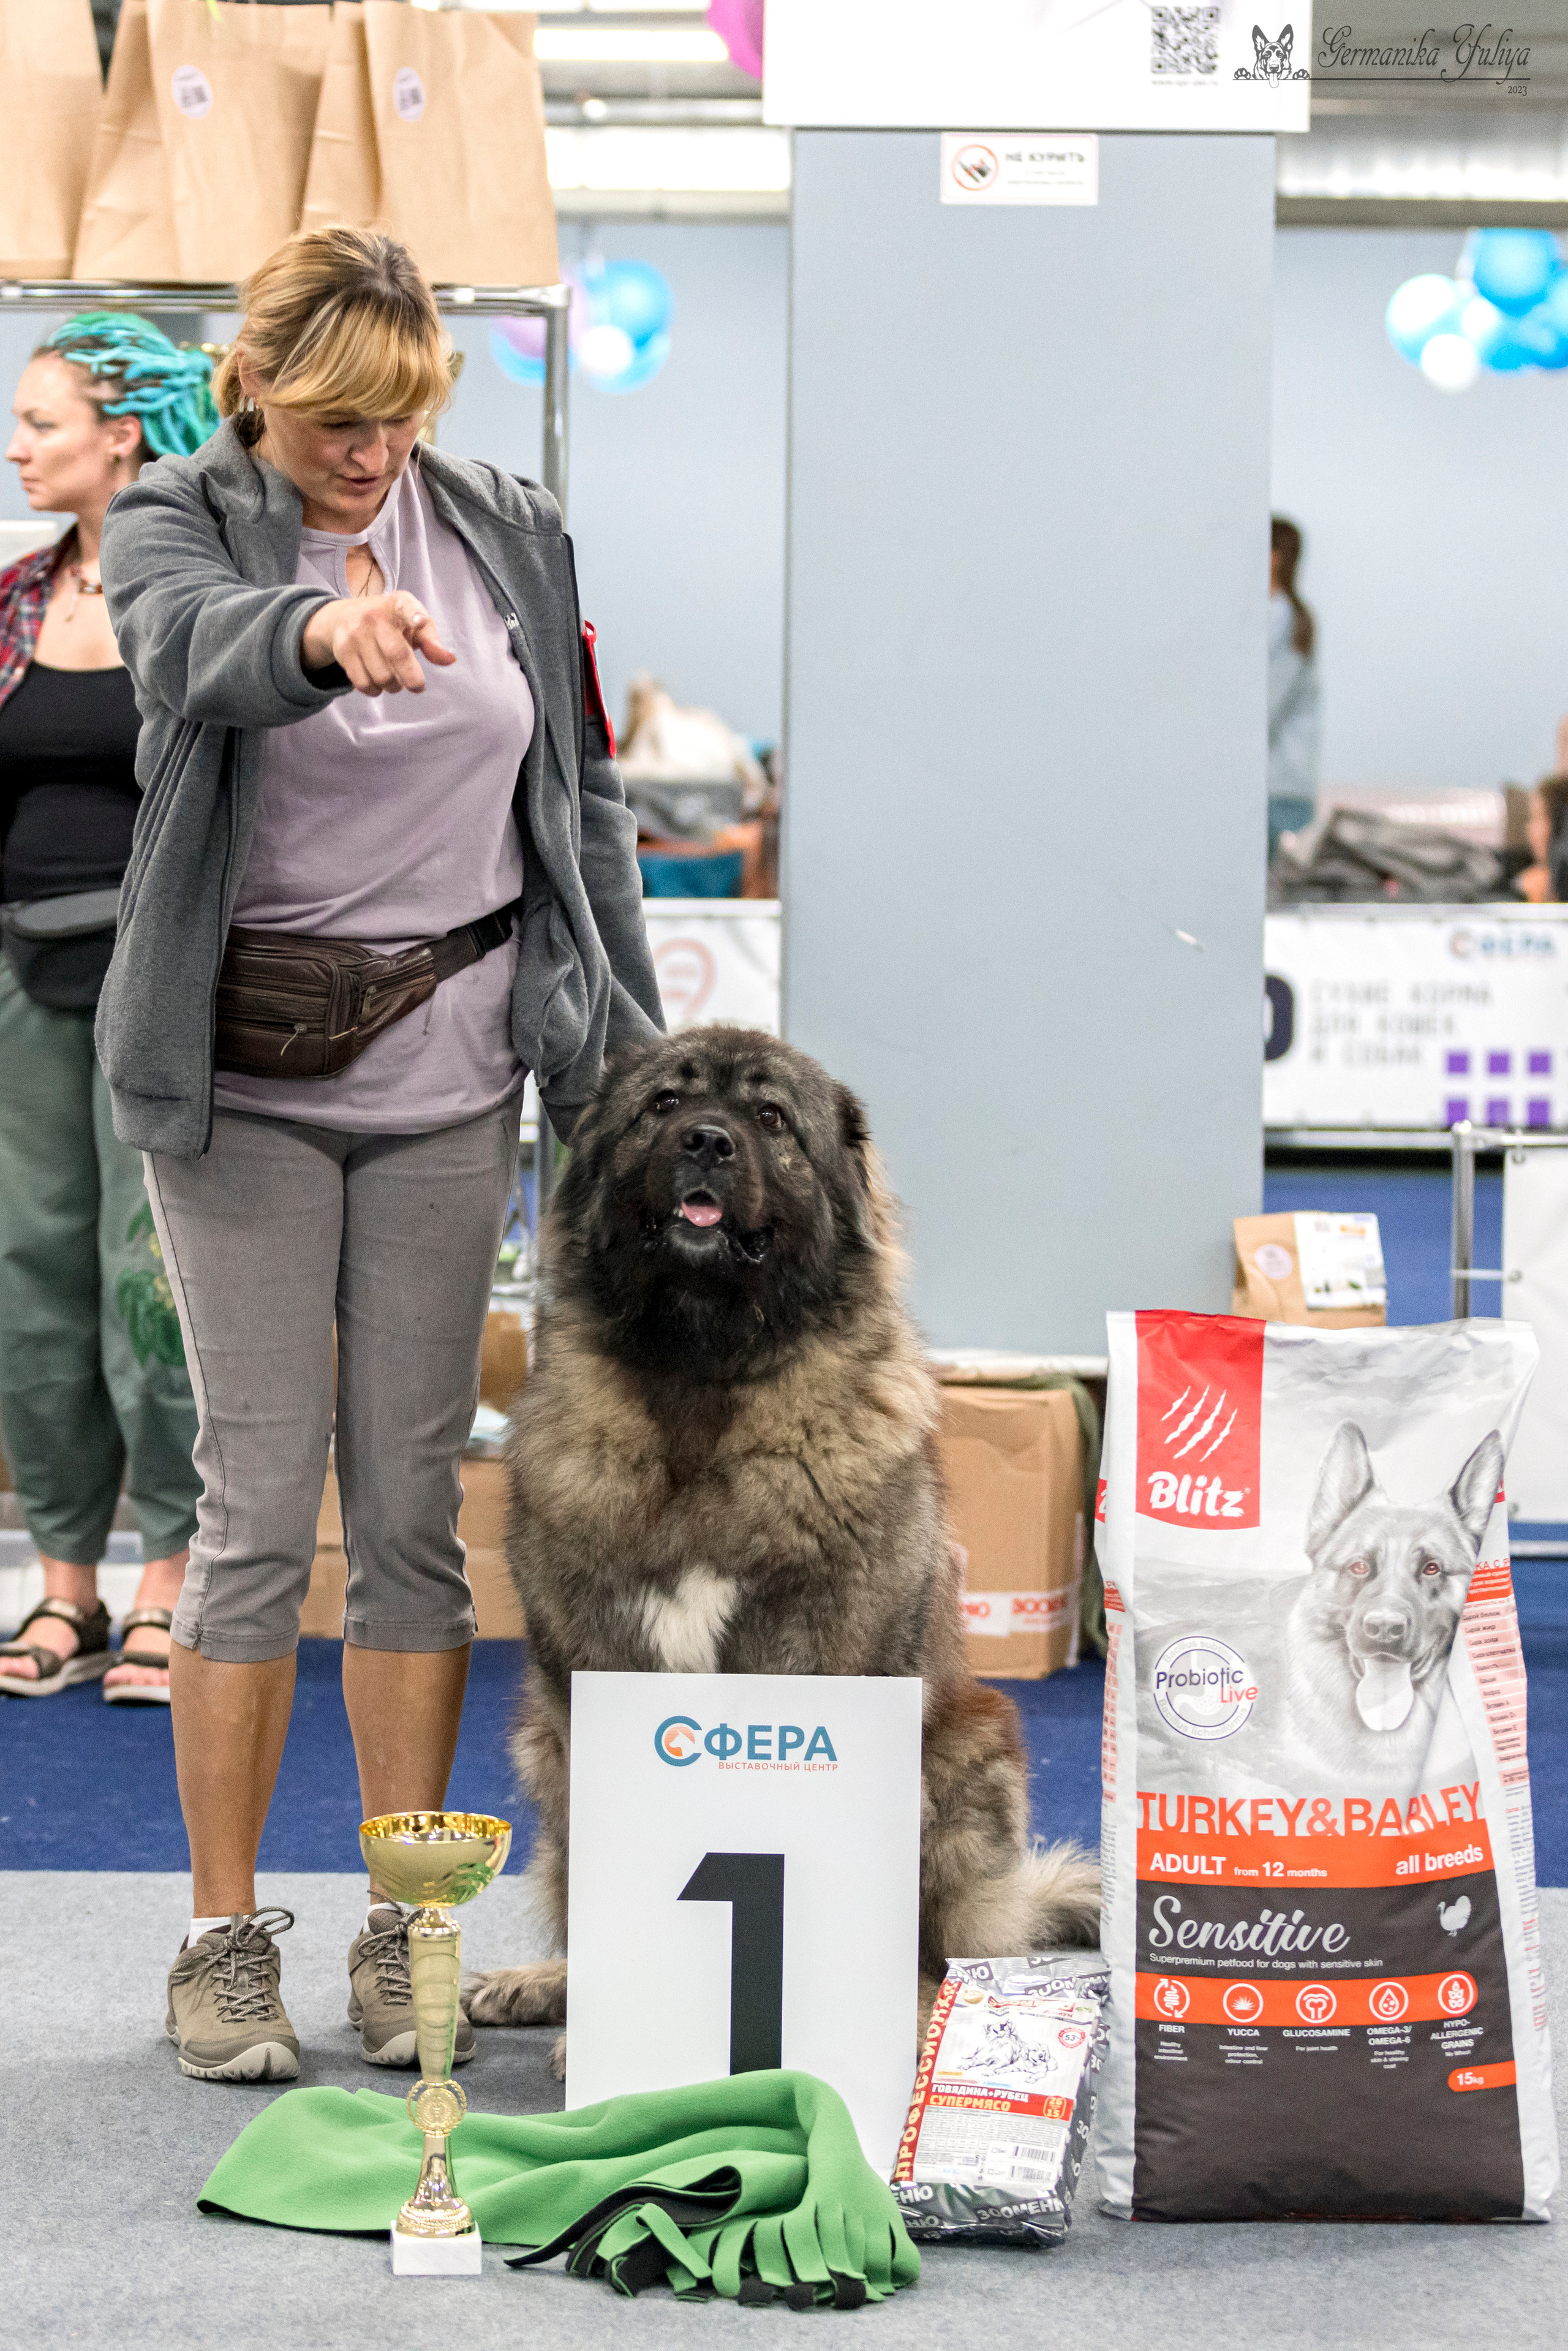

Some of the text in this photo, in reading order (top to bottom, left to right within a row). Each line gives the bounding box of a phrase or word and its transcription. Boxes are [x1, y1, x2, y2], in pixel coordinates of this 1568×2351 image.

[1147, 1471, 1245, 1517] Blitz
[1156, 1667, 1243, 1689] Probiotic
[1221, 1686, 1259, 1703] Live
[654, 1715, 837, 1767] СФЕРА
[718, 1762, 838, 1773] ВЫСТАВОЧНЫЙ ЦЕНТР
[1137, 1781, 1480, 1836] TURKEY&BARLEY
[1150, 1852, 1328, 1877] ADULT from 12 months
[1395, 1844, 1484, 1875] all breeds
[1148, 1895, 1351, 1956] Sensitive
[676, 1852, 785, 2076] 1
[1150, 1953, 1384, 1970] Superpremium petfood for dogs with sensitive skin
[1159, 2024, 1185, 2033] FIBER
[1430, 2027, 1483, 2040] ALLERGENIC
[1368, 2036, 1411, 2045] OMEGA-6
[1441, 2039, 1474, 2049] GRAINS
[1457, 2072, 1484, 2085] 15kg
[932, 2084, 1029, 2102] ГОВЯДИНА+РУБЕЦ
[1049, 2097, 1063, 2105] 26
[929, 2094, 1011, 2111] СУПЕРМЯСО
[1047, 2108, 1060, 2117] 15
